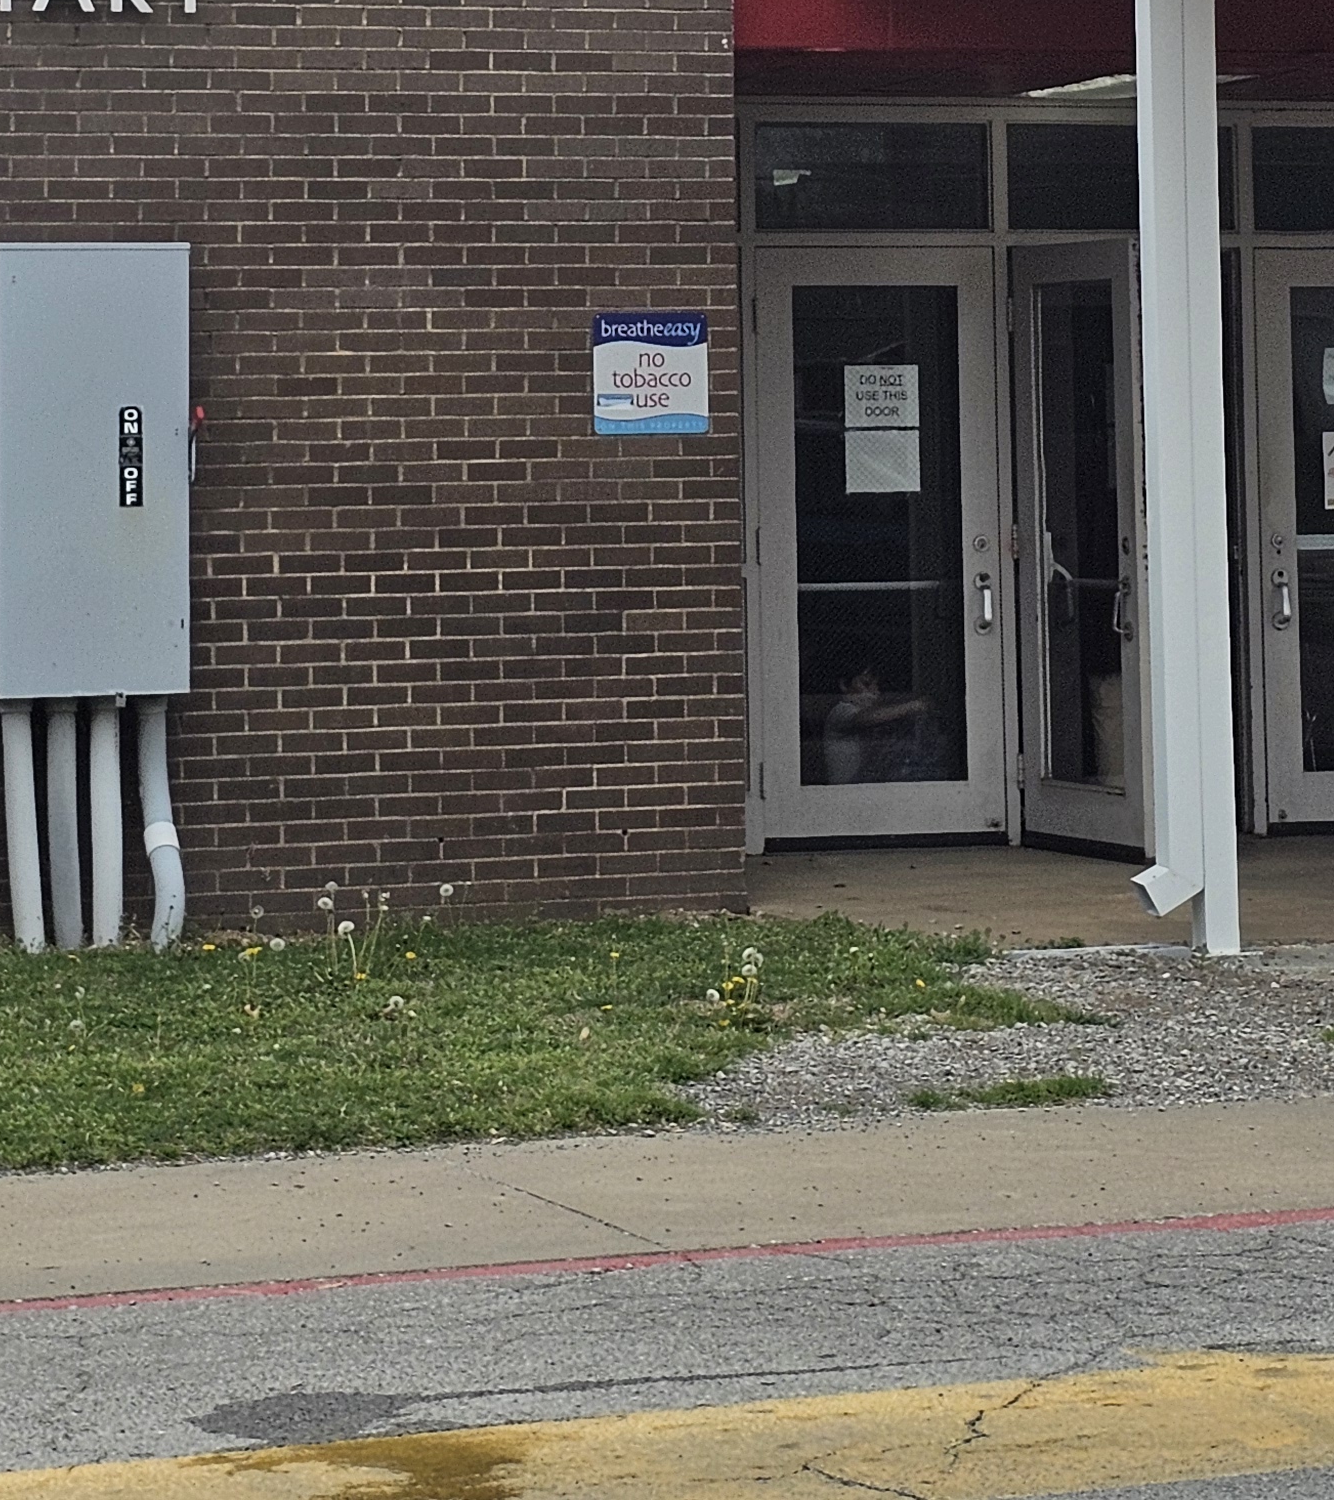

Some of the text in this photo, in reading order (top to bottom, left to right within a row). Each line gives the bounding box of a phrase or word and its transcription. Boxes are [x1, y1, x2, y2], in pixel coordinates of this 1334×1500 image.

[639, 353, 665, 368] no
[612, 368, 692, 388] tobacco
[859, 374, 903, 386] DO NOT
[636, 392, 670, 408] use
[856, 390, 908, 401] USE THIS
[865, 406, 900, 417] DOOR
[124, 409, 138, 434] ON
[124, 467, 138, 505] OFF
